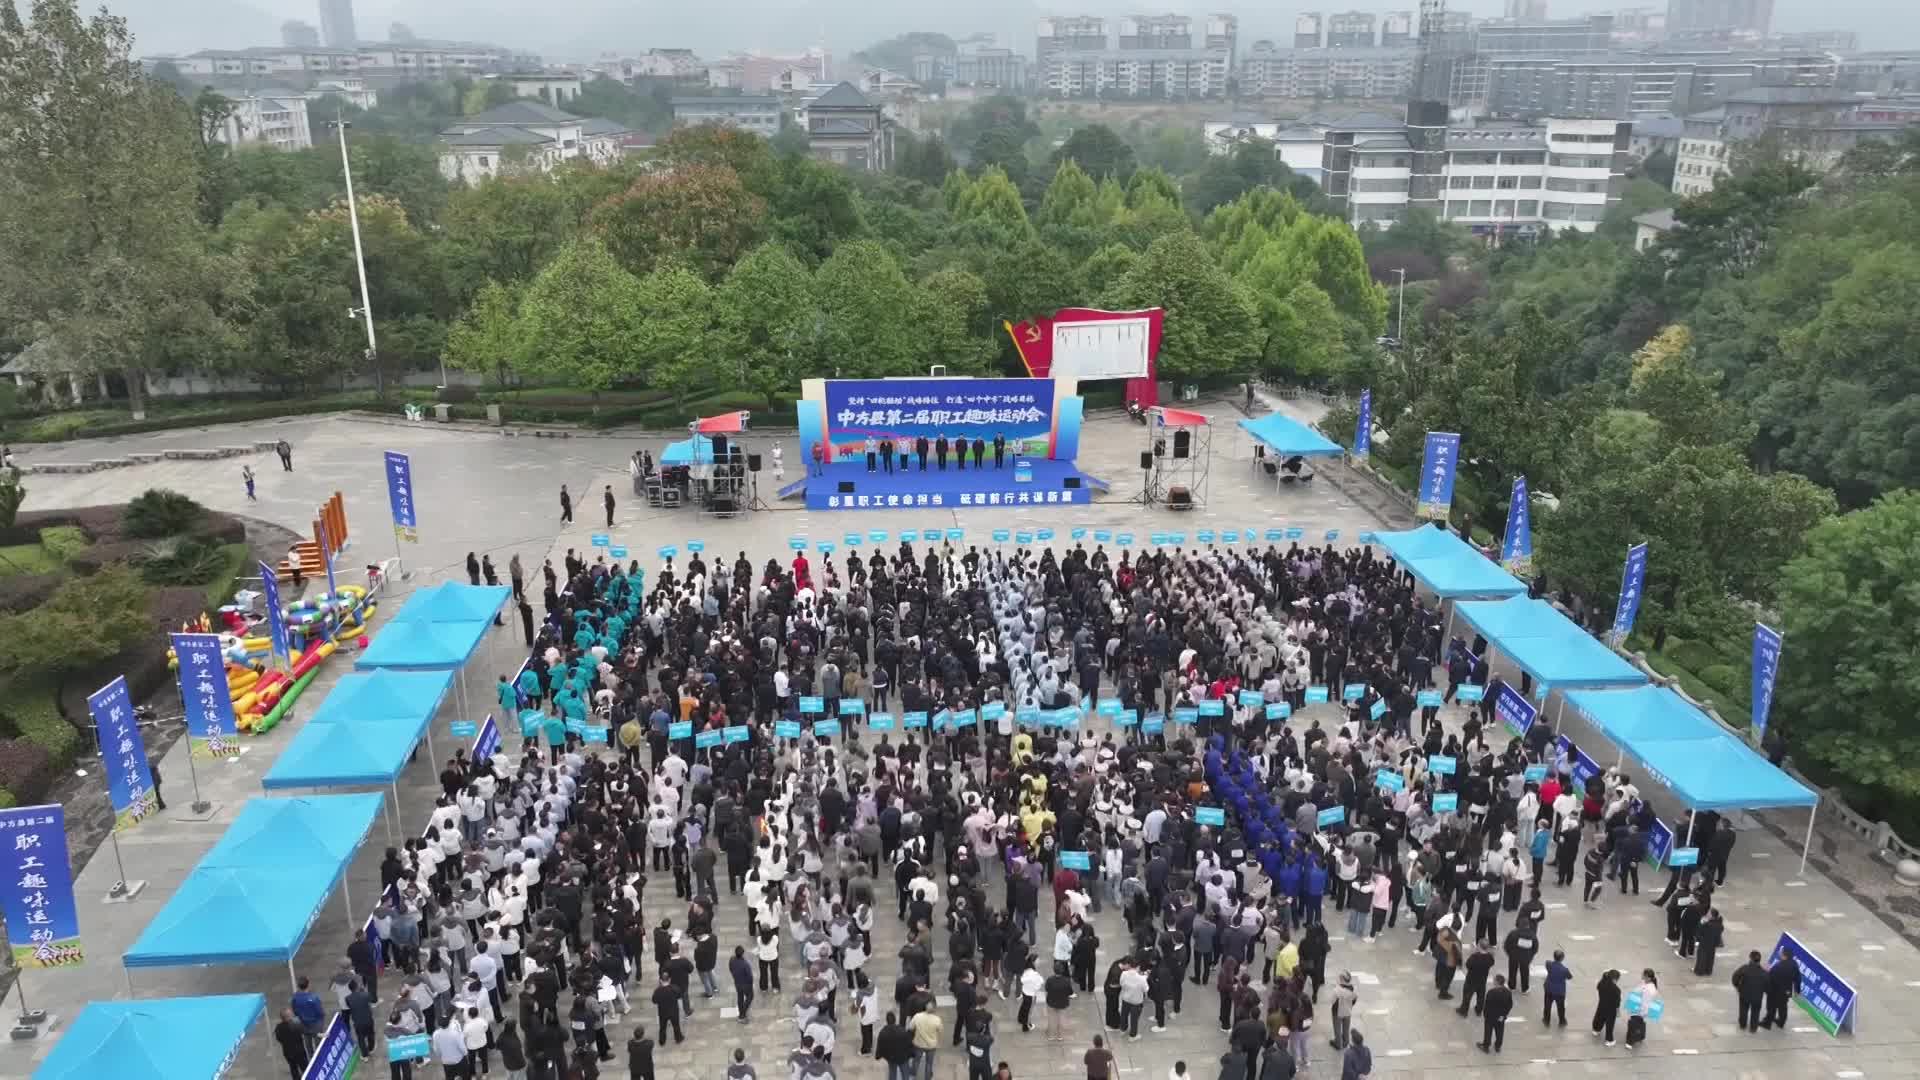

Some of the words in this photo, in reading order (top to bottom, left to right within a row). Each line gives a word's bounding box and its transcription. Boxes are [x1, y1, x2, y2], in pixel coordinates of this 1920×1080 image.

[837, 406, 1047, 428] 中方县第二届职工趣味运动会
[191, 652, 224, 750] 职工趣味运动会
[14, 833, 58, 960] 职工趣味运动会
